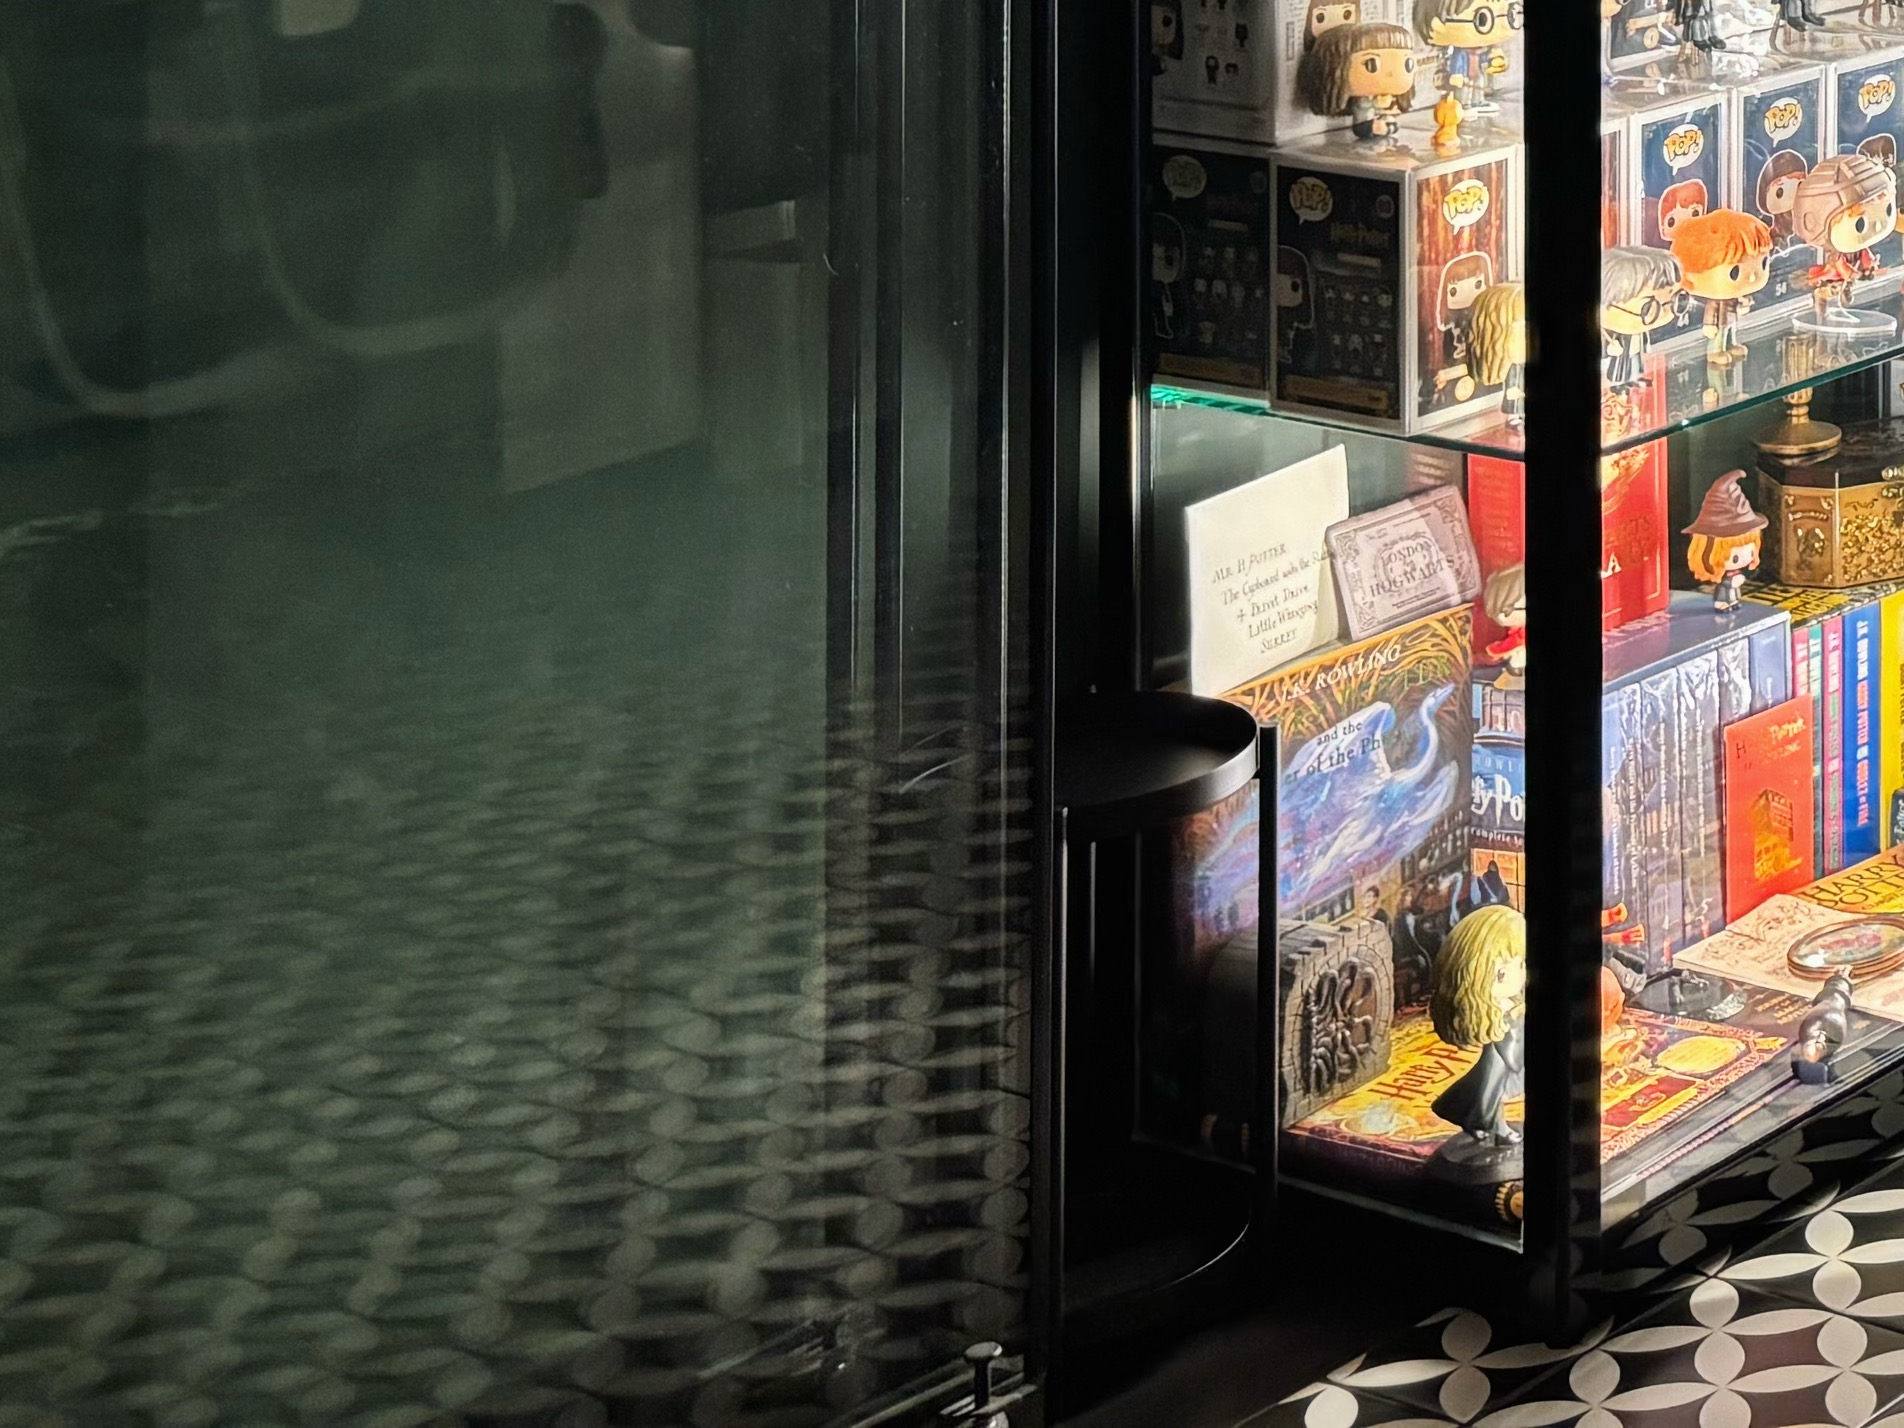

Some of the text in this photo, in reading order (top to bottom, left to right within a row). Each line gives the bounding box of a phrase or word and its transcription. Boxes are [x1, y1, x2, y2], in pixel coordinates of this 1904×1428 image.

[1859, 78, 1896, 109] POP!
[1764, 103, 1802, 134] POP!
[1663, 129, 1703, 161] POP!
[1445, 184, 1489, 218] POP!
[1244, 543, 1287, 577] POTTER
[1381, 539, 1432, 566] LONDON
[1369, 553, 1455, 598] HOGWARTS
[1315, 644, 1401, 692] ROWLING
[1316, 721, 1363, 747] and the
[1306, 760, 1325, 781] of
[1327, 746, 1355, 771] the
[1801, 854, 1901, 901] HARRY
[1367, 1058, 1457, 1101] Harry
